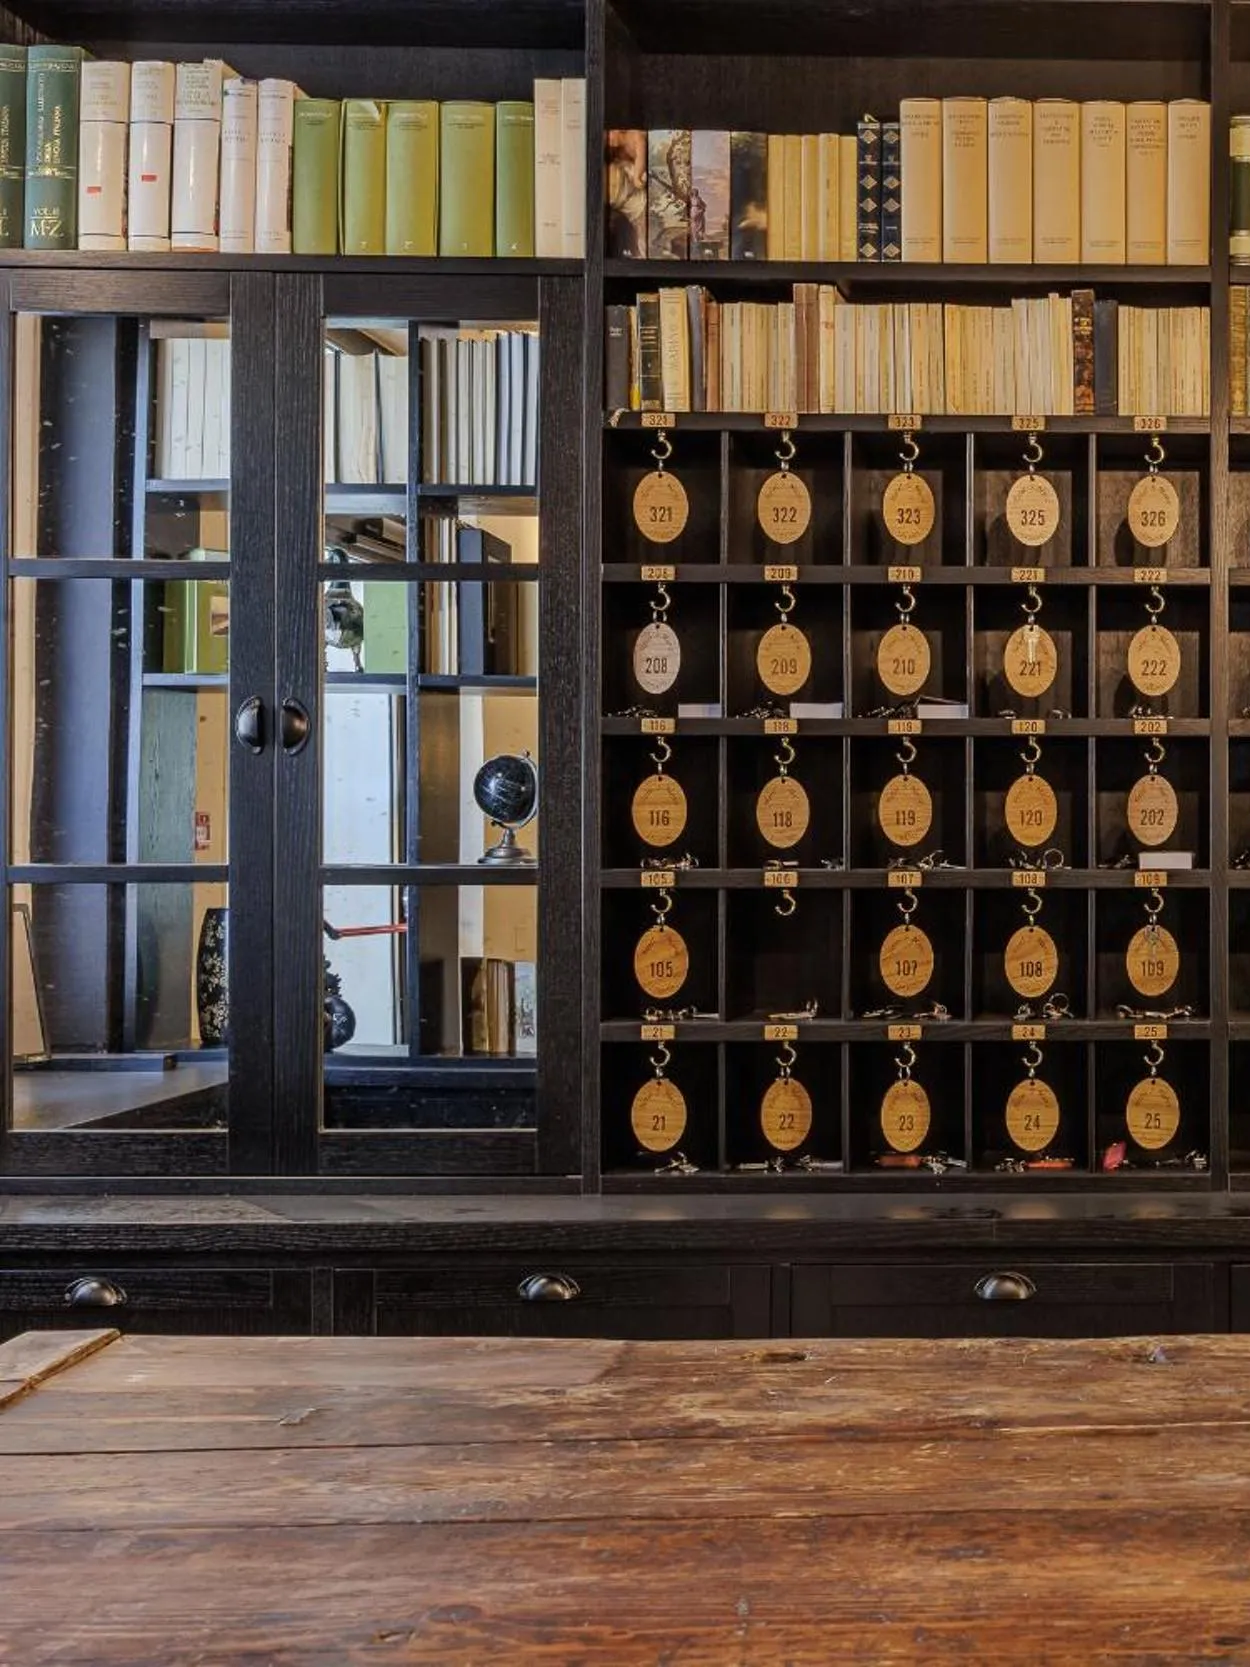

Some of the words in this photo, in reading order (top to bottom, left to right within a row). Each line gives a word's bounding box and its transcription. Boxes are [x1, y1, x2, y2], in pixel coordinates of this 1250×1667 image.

[771, 416, 791, 426] 322
[1019, 417, 1039, 428] 325
[650, 506, 673, 523] 321
[772, 506, 798, 523] 322
[897, 507, 921, 524] 323
[1020, 510, 1045, 526] 325
[1141, 511, 1166, 527] 326
[1019, 570, 1038, 580] 221
[1141, 570, 1161, 581] 222
[645, 658, 668, 674] 208
[772, 658, 798, 675] 209
[892, 658, 915, 675] 210
[1019, 660, 1041, 676] 221
[1141, 660, 1167, 676] 222
[1019, 722, 1037, 733] 120
[1141, 722, 1161, 732] 202
[649, 810, 670, 826] 116
[773, 811, 792, 827] 118
[895, 810, 916, 826] 119
[1019, 809, 1043, 826] 120
[1140, 809, 1164, 826] 202
[648, 874, 668, 885] 105
[896, 874, 914, 884] 107
[1019, 874, 1037, 884] 108
[1141, 874, 1160, 885] 109
[650, 961, 673, 978] 105
[1019, 960, 1043, 977] 108
[1140, 960, 1164, 977] 109
[652, 1027, 663, 1037] 21
[774, 1027, 788, 1037] 22
[898, 1028, 911, 1038] 23
[1022, 1027, 1035, 1037] 24
[1144, 1027, 1158, 1037] 25
[652, 1115, 666, 1131] 21
[779, 1113, 795, 1130] 22
[899, 1115, 914, 1131] 23
[1024, 1114, 1040, 1131] 24
[1144, 1113, 1161, 1129] 25
